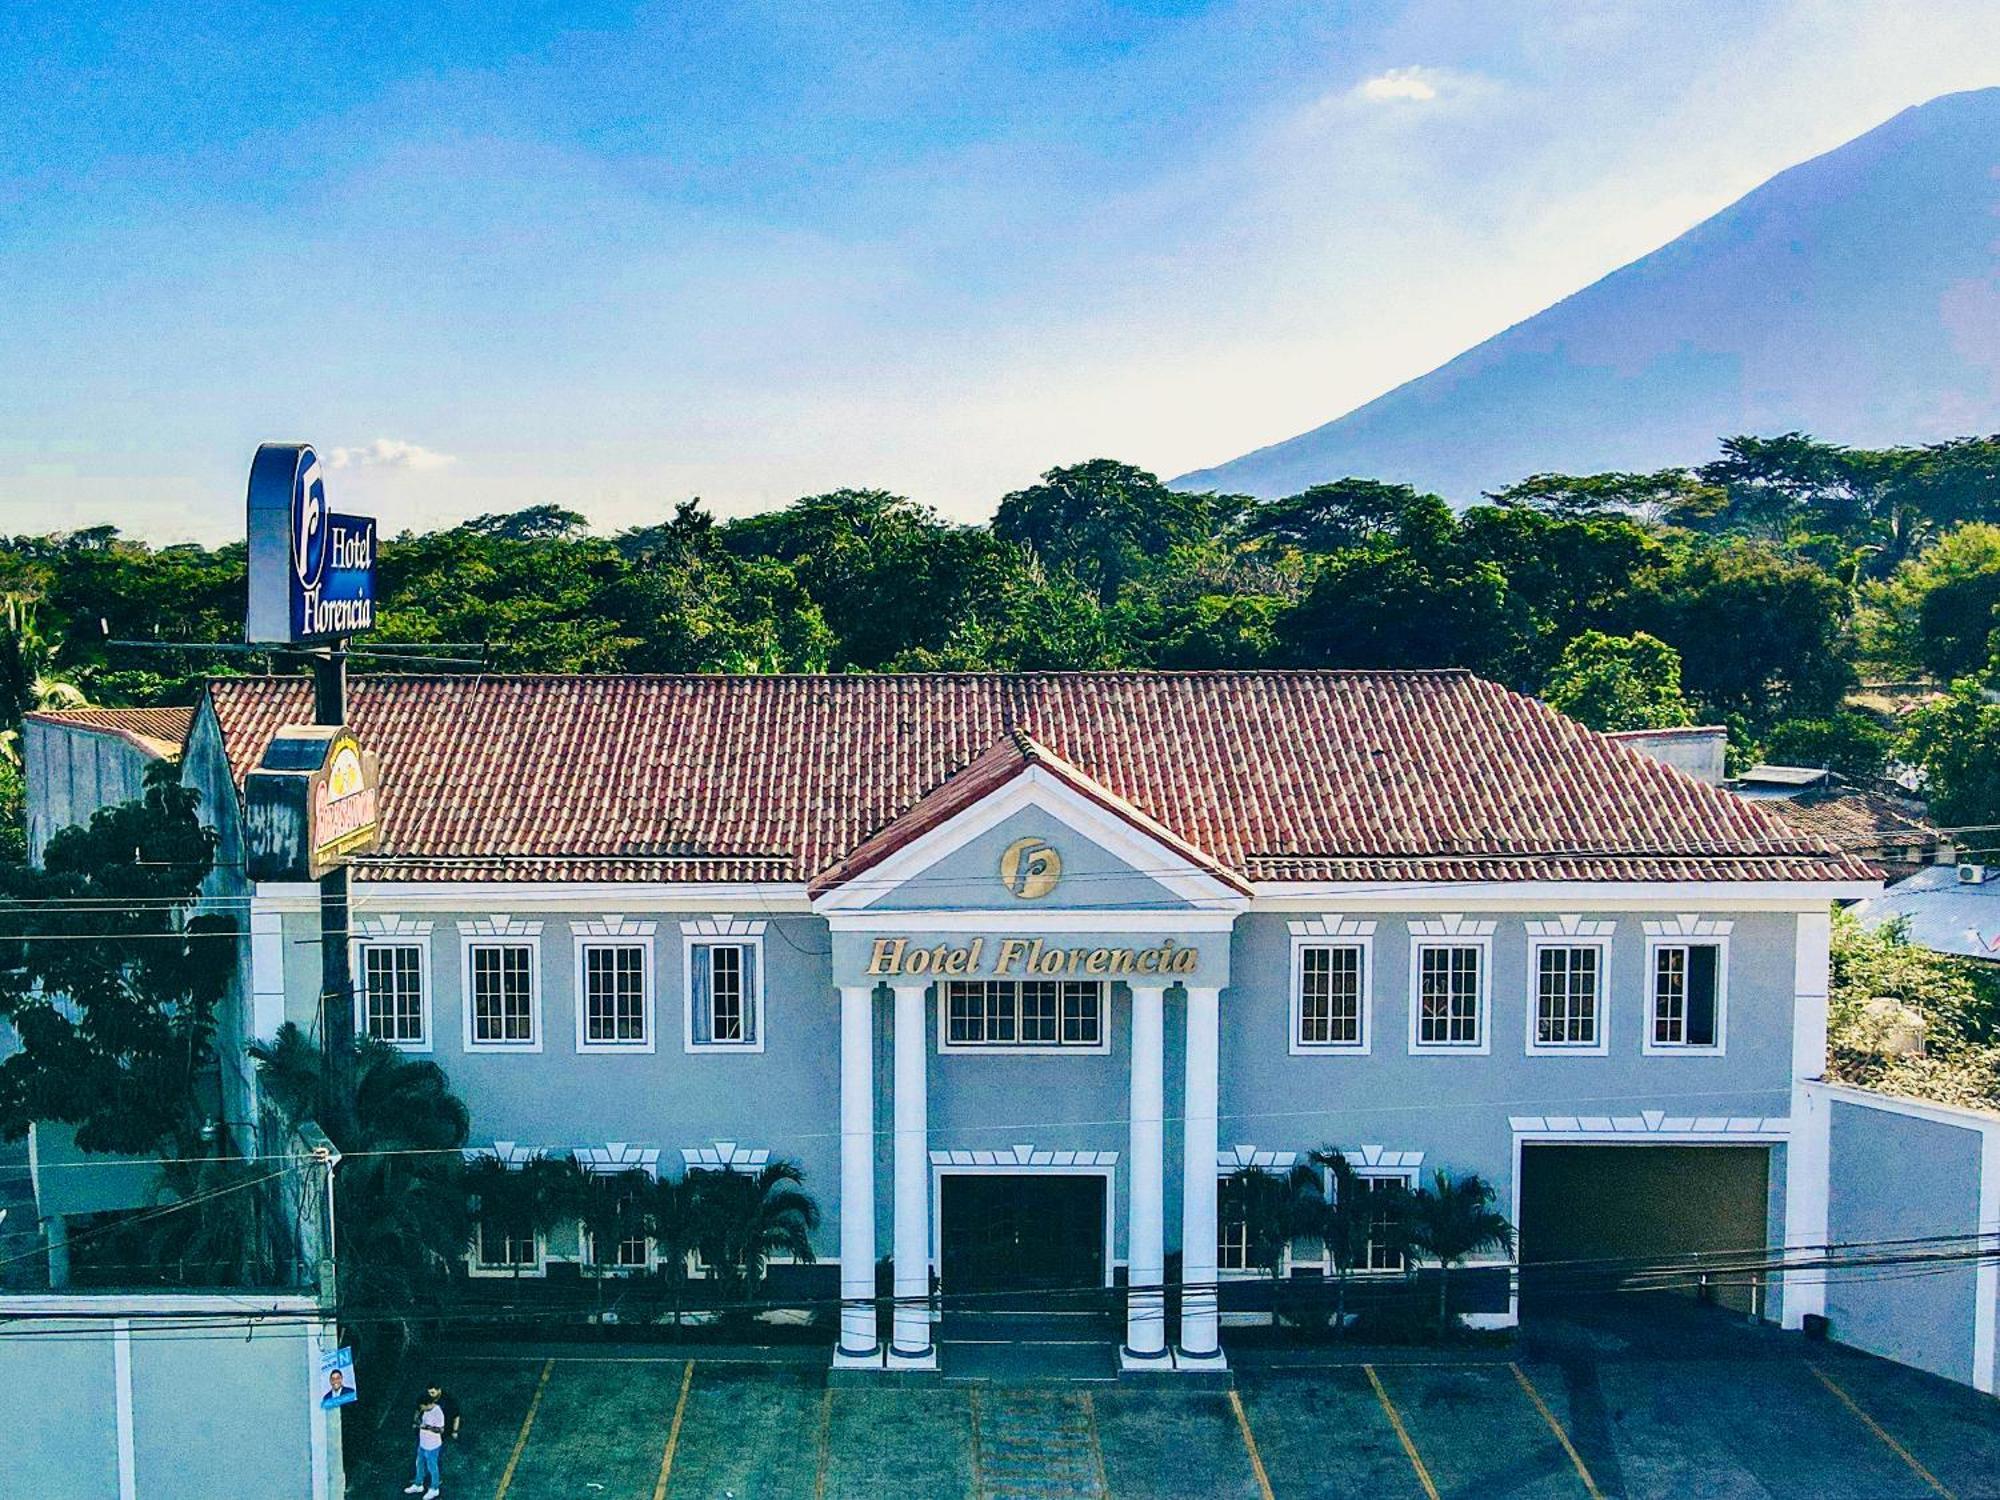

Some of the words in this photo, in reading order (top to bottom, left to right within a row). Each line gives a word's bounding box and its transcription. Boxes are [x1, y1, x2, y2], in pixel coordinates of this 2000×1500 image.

[331, 524, 373, 569] Hotel
[302, 583, 371, 634] Florencia
[867, 937, 983, 976] Hotel
[992, 937, 1198, 976] Florencia
